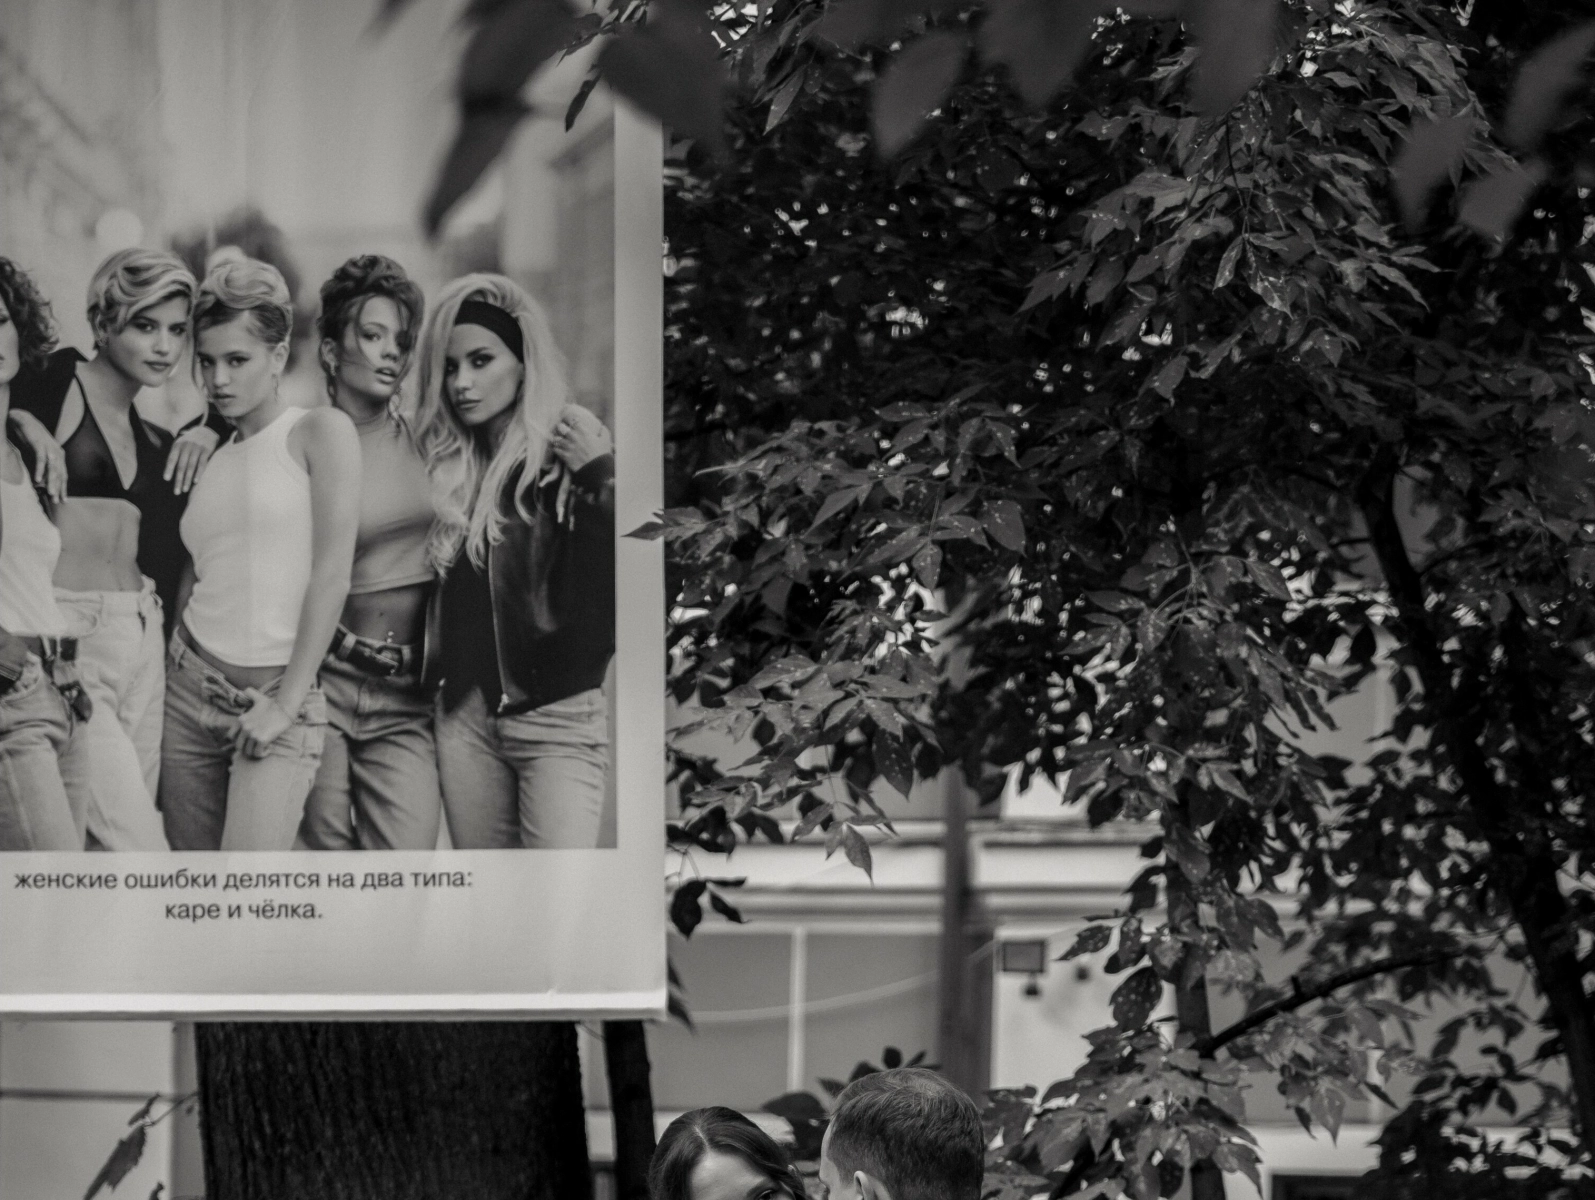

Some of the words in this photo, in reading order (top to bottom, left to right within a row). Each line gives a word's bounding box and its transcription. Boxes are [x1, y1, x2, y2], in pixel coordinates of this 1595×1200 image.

[14, 874, 118, 889] женские
[124, 868, 217, 889] ошибки
[223, 873, 320, 891] делятся
[327, 873, 355, 888] на
[361, 872, 403, 891] два
[411, 872, 473, 888] типа:
[165, 903, 221, 923] каре
[228, 904, 241, 919] и
[248, 898, 323, 920] чёлка.
